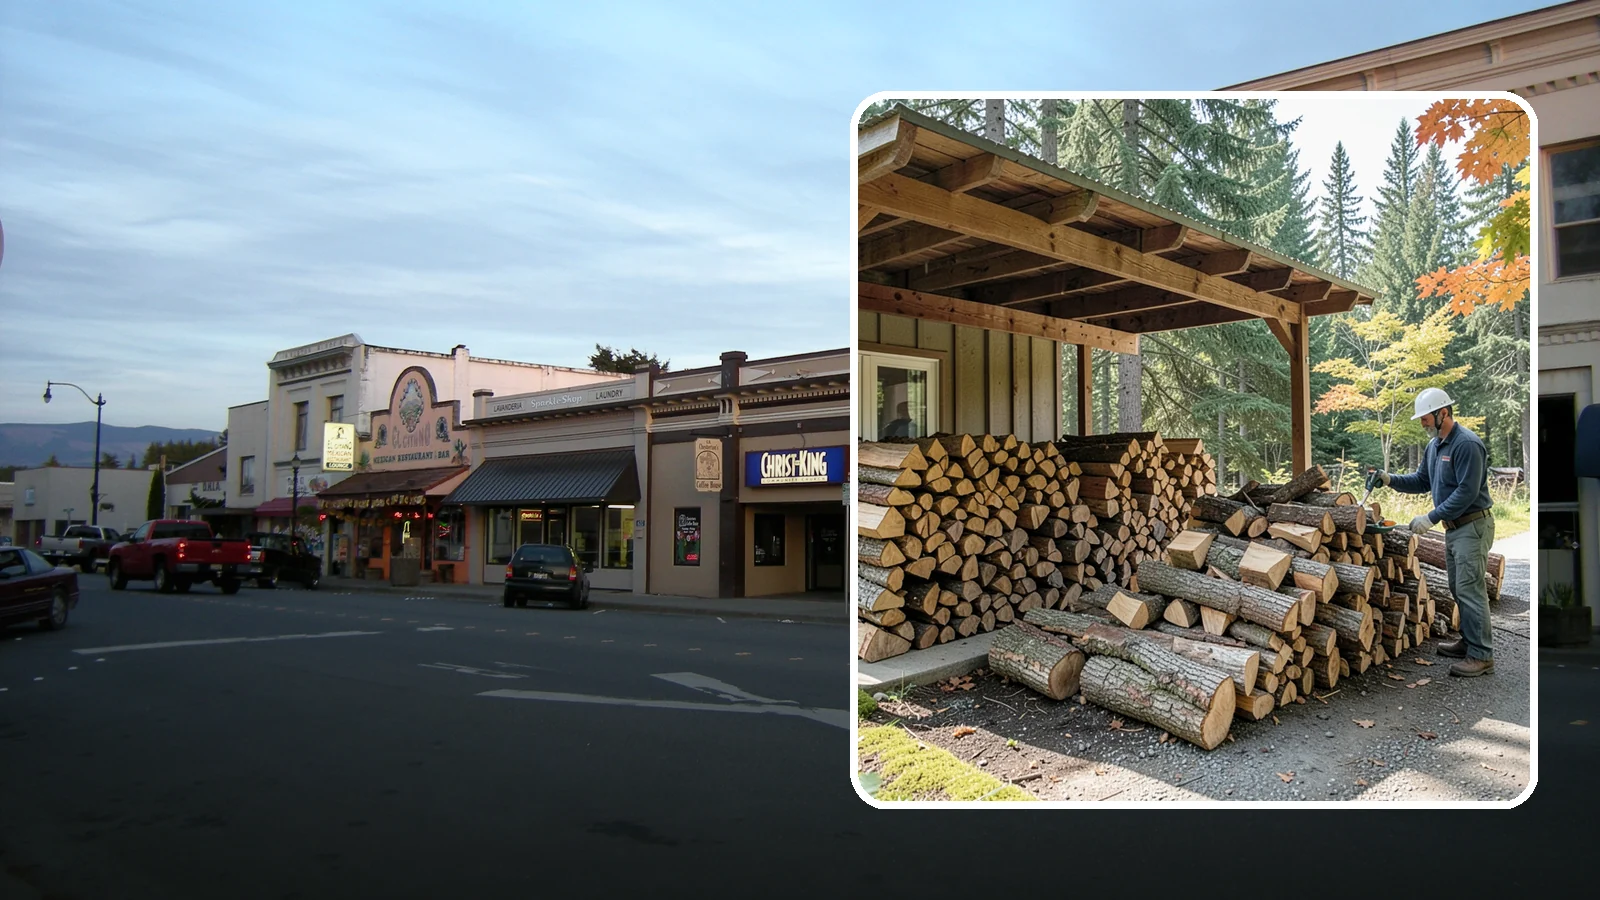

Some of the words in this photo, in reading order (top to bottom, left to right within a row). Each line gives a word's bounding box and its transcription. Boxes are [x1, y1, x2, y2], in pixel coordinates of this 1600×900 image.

[596, 389, 623, 400] LAUNDRY
[493, 402, 523, 412] LAVANDERIA
[373, 454, 396, 464] MEXICAN
[397, 451, 433, 462] RESTAURANT
[437, 450, 450, 459] BAR
[696, 480, 709, 488] Coffee
